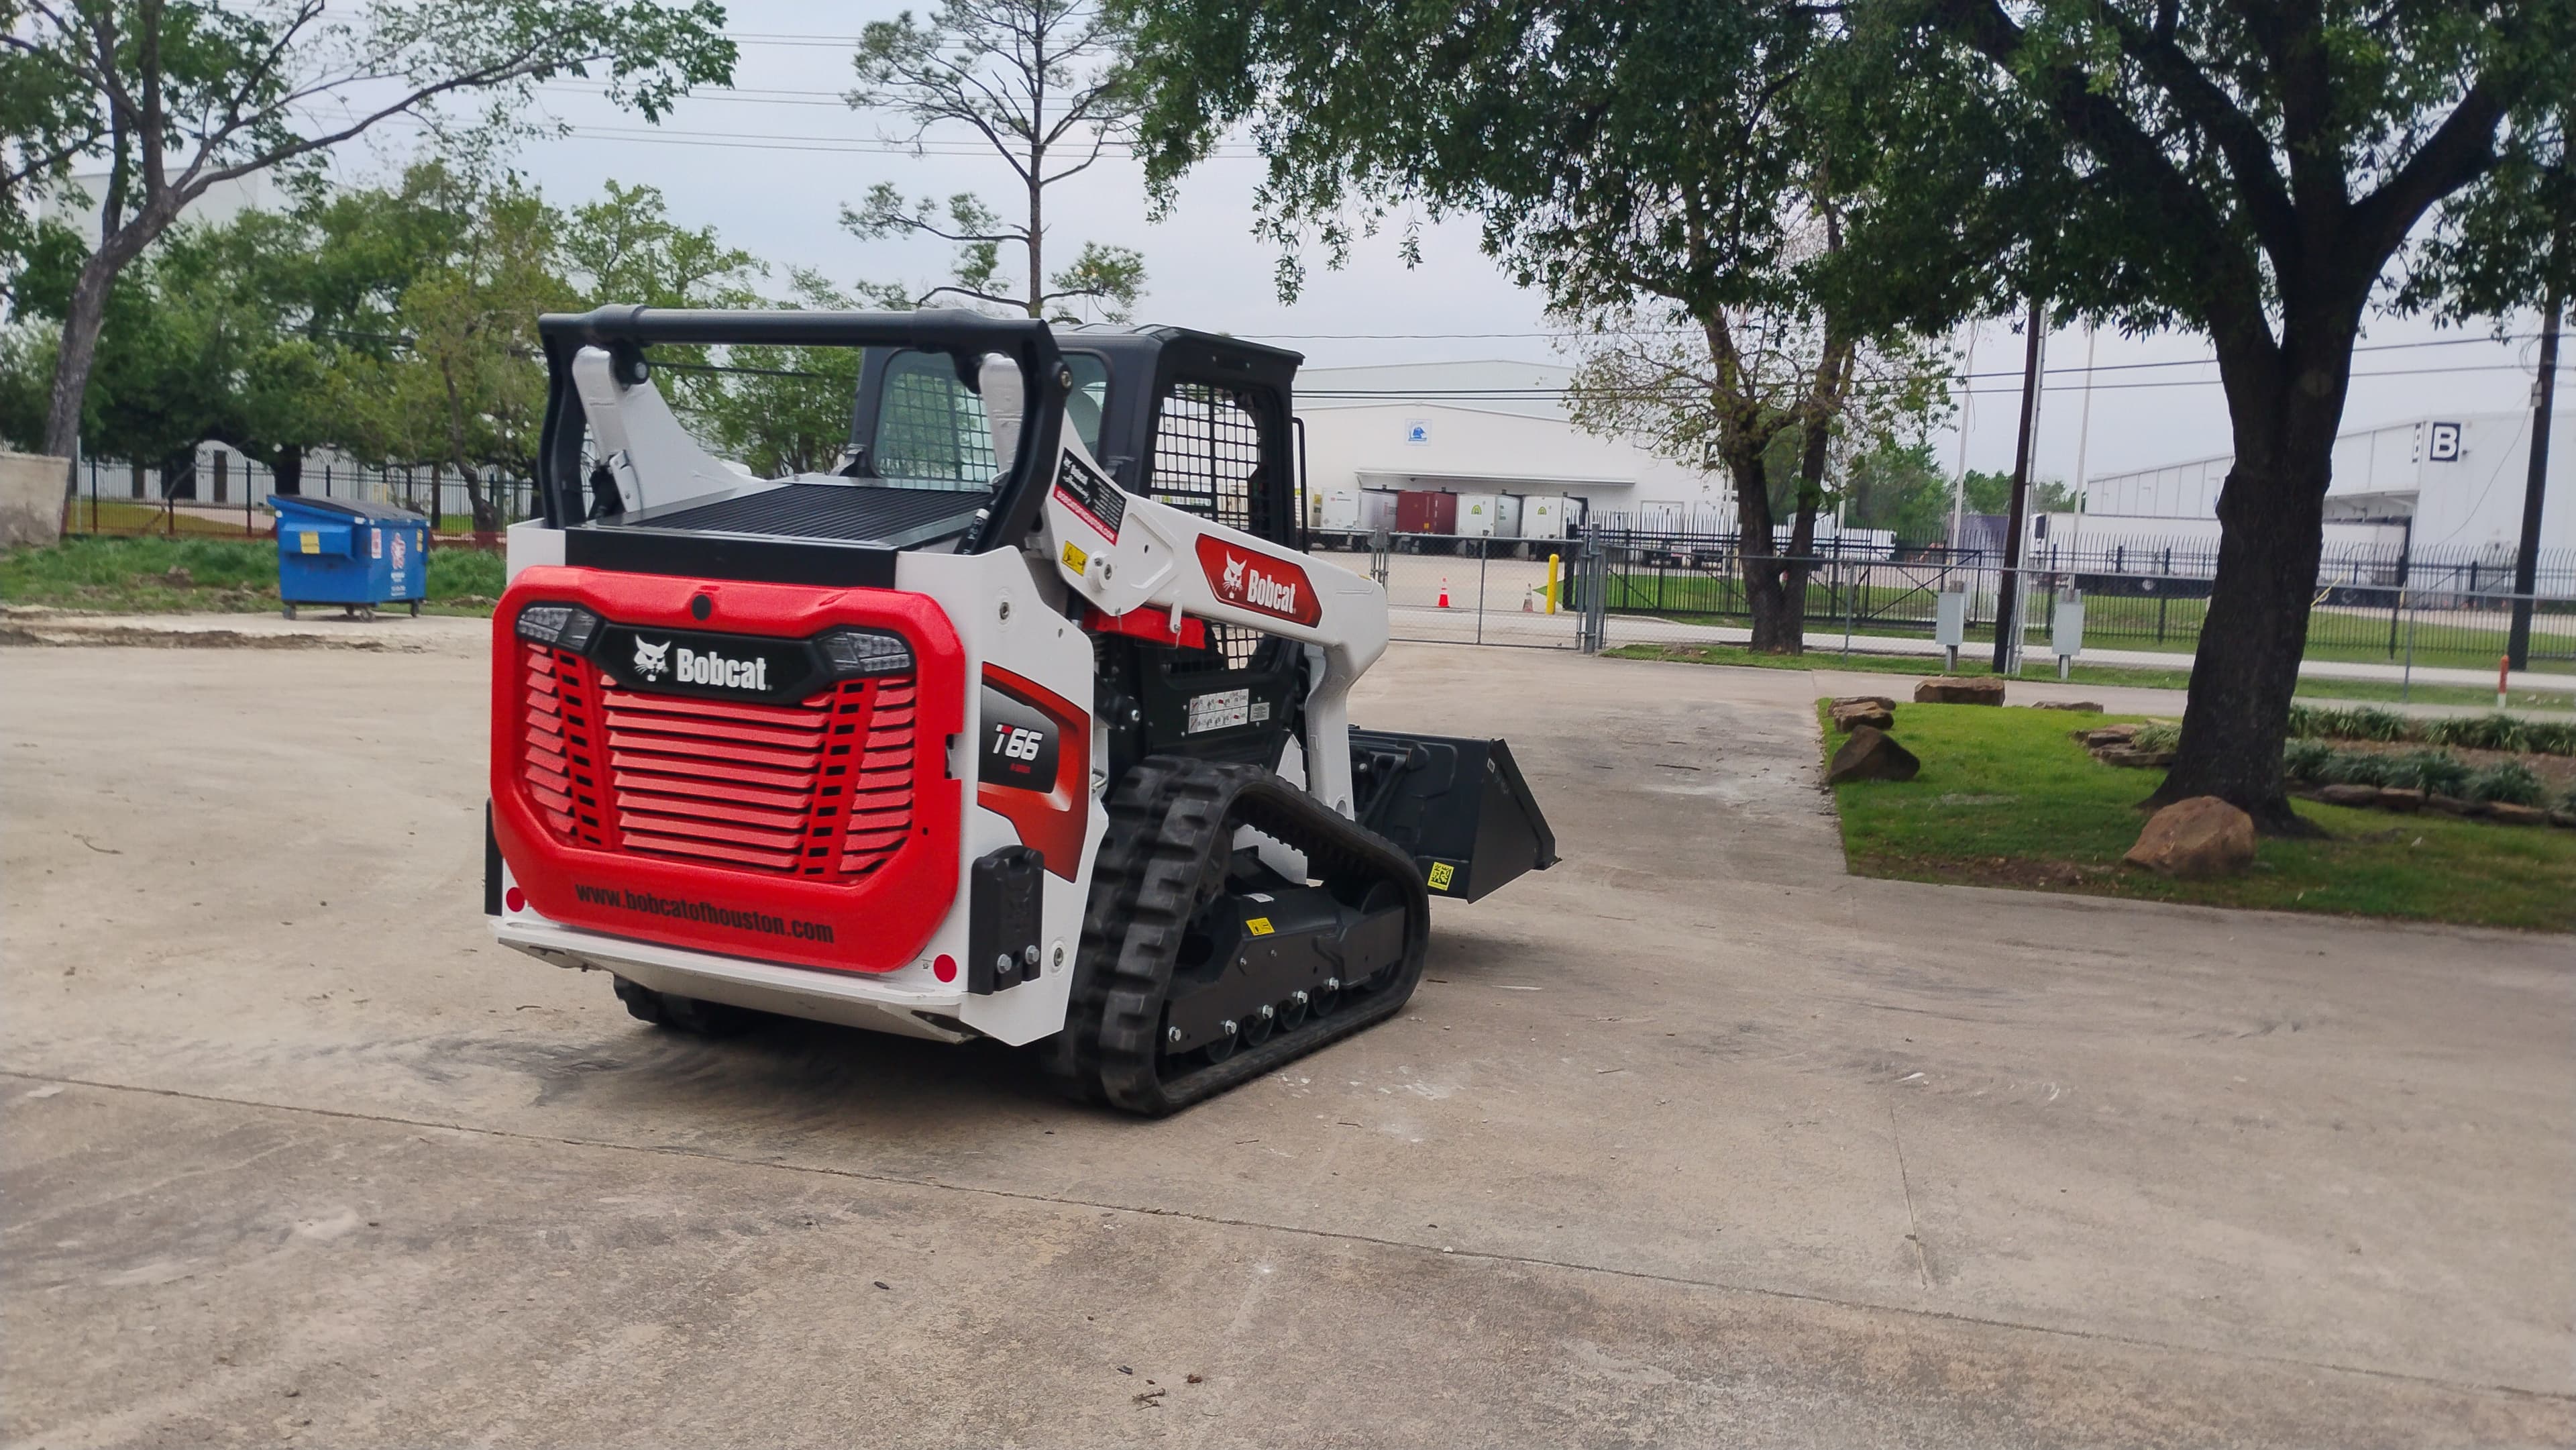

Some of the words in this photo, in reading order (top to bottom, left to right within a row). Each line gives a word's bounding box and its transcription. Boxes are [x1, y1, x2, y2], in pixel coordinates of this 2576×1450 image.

[2432, 425, 2458, 458] B
[1247, 569, 1296, 614] Bobcat
[676, 648, 767, 690] Bobcat
[993, 724, 1043, 761] T66
[575, 883, 835, 944] www.bobcatofhouston.com
